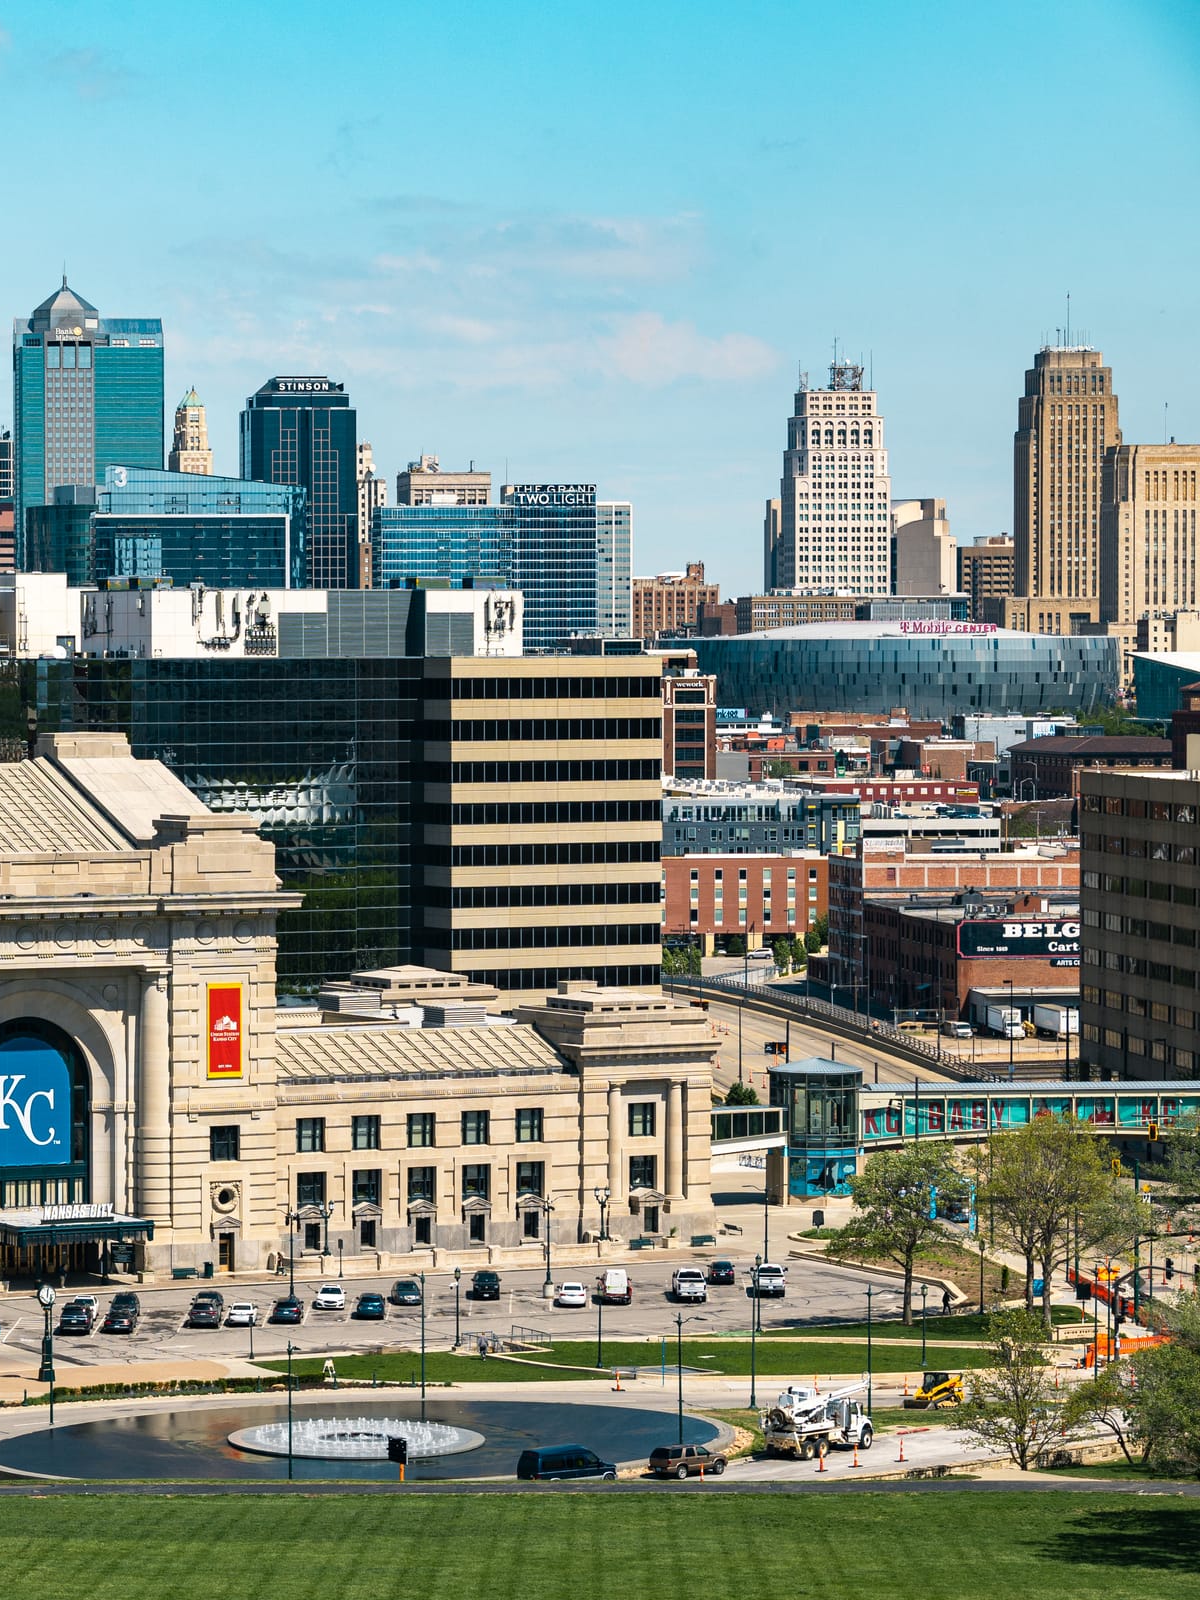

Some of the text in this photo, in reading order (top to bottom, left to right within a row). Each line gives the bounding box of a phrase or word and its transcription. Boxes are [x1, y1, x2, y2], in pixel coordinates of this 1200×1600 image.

[55, 327, 73, 335] Bank
[279, 382, 329, 391] STINSON
[114, 466, 128, 488] 3
[514, 485, 596, 493] THE GRAND
[518, 494, 593, 504] TWO LIGHT
[912, 622, 951, 633] Mobile
[955, 624, 997, 632] CENTER
[1048, 941, 1080, 951] Cart
[864, 1101, 1005, 1134] KC BABY
[43, 1202, 114, 1220] KANSAS CITY
